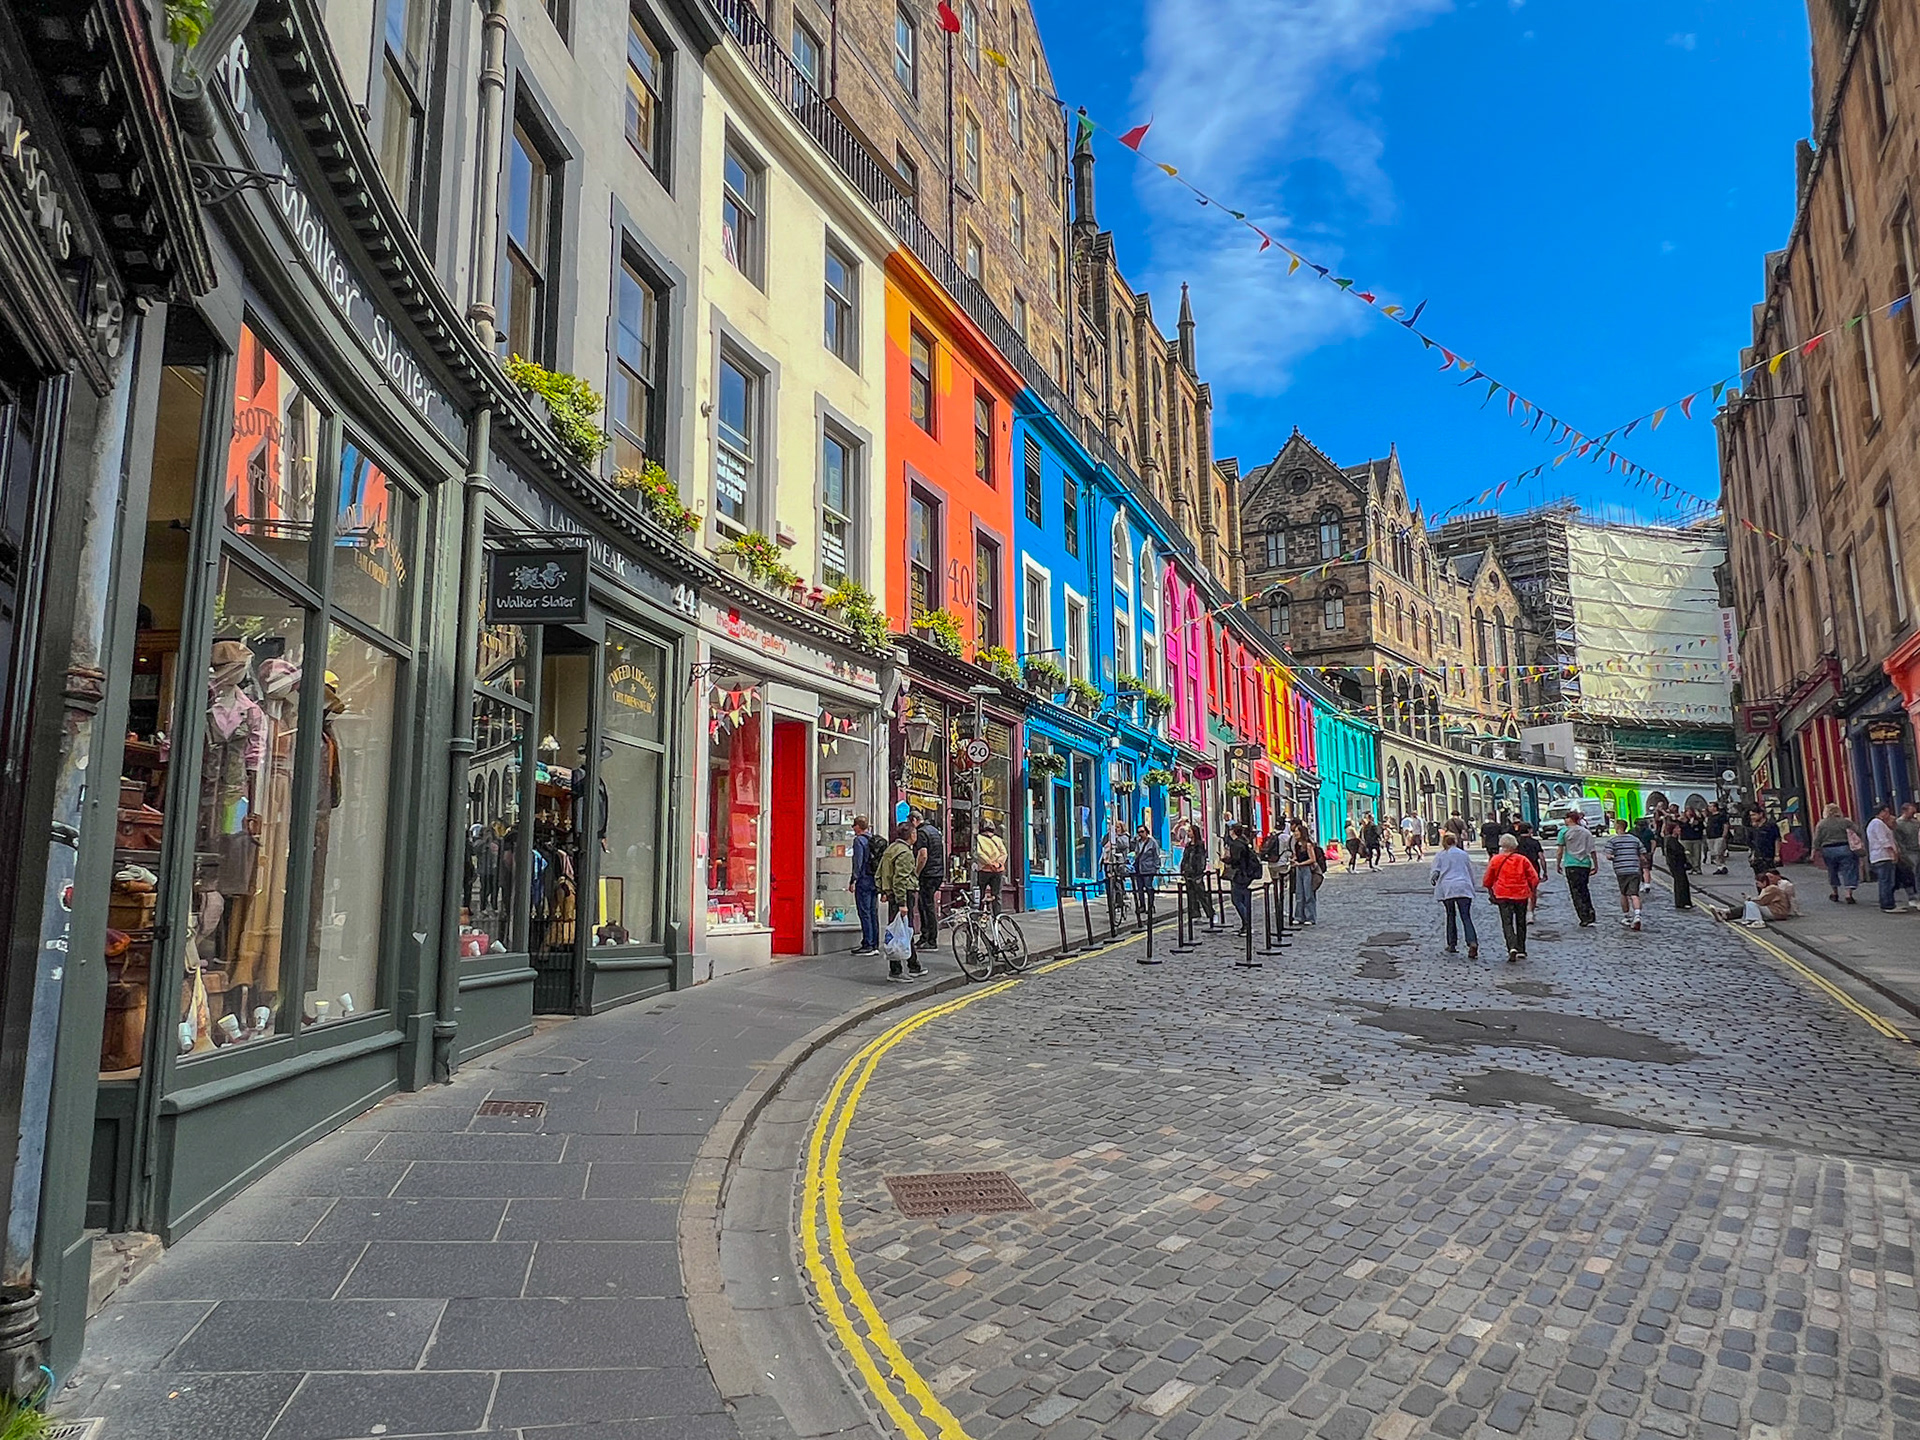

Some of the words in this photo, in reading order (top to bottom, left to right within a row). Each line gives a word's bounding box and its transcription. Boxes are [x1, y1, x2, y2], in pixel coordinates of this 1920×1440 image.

[281, 161, 360, 318] Walker
[371, 316, 437, 415] Slater
[948, 558, 970, 608] 40
[496, 595, 539, 608] Walker
[541, 595, 576, 608] Slater
[741, 626, 758, 642] door
[761, 635, 787, 656] gallery
[970, 746, 988, 757] 20
